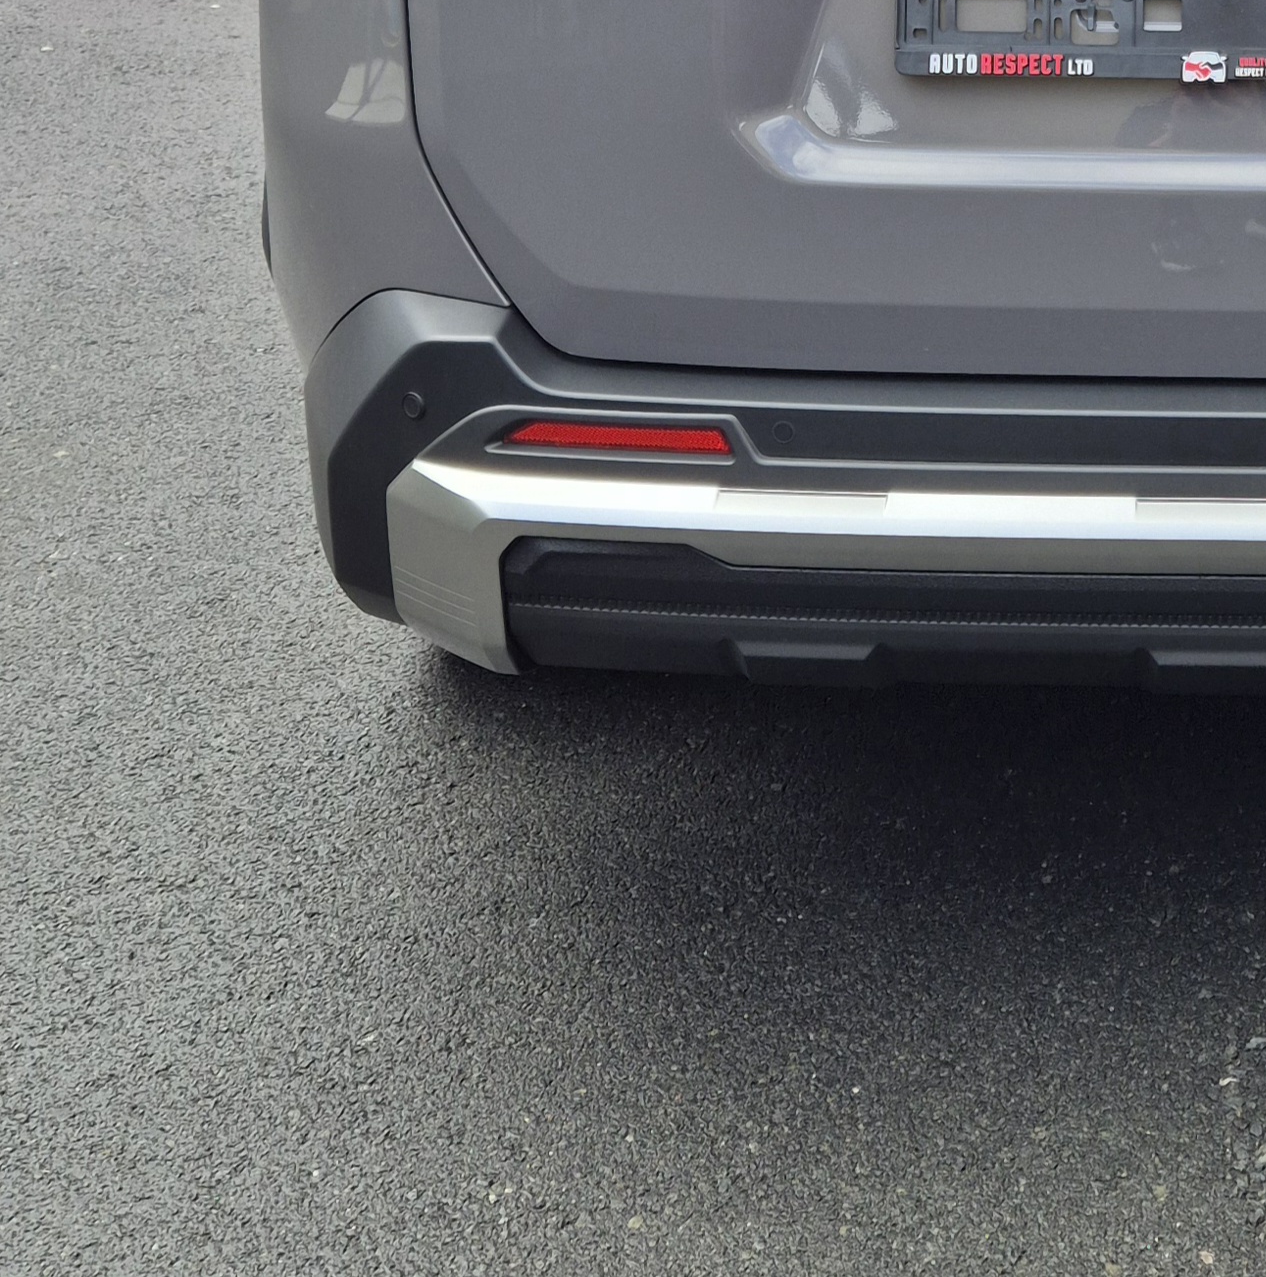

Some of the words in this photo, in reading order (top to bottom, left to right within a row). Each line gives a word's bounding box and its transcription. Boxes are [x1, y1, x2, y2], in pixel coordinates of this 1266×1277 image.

[929, 53, 978, 75] AUTO
[980, 54, 1064, 76] RESPECT
[1068, 59, 1094, 76] LTD
[1235, 67, 1264, 77] RESPECT
